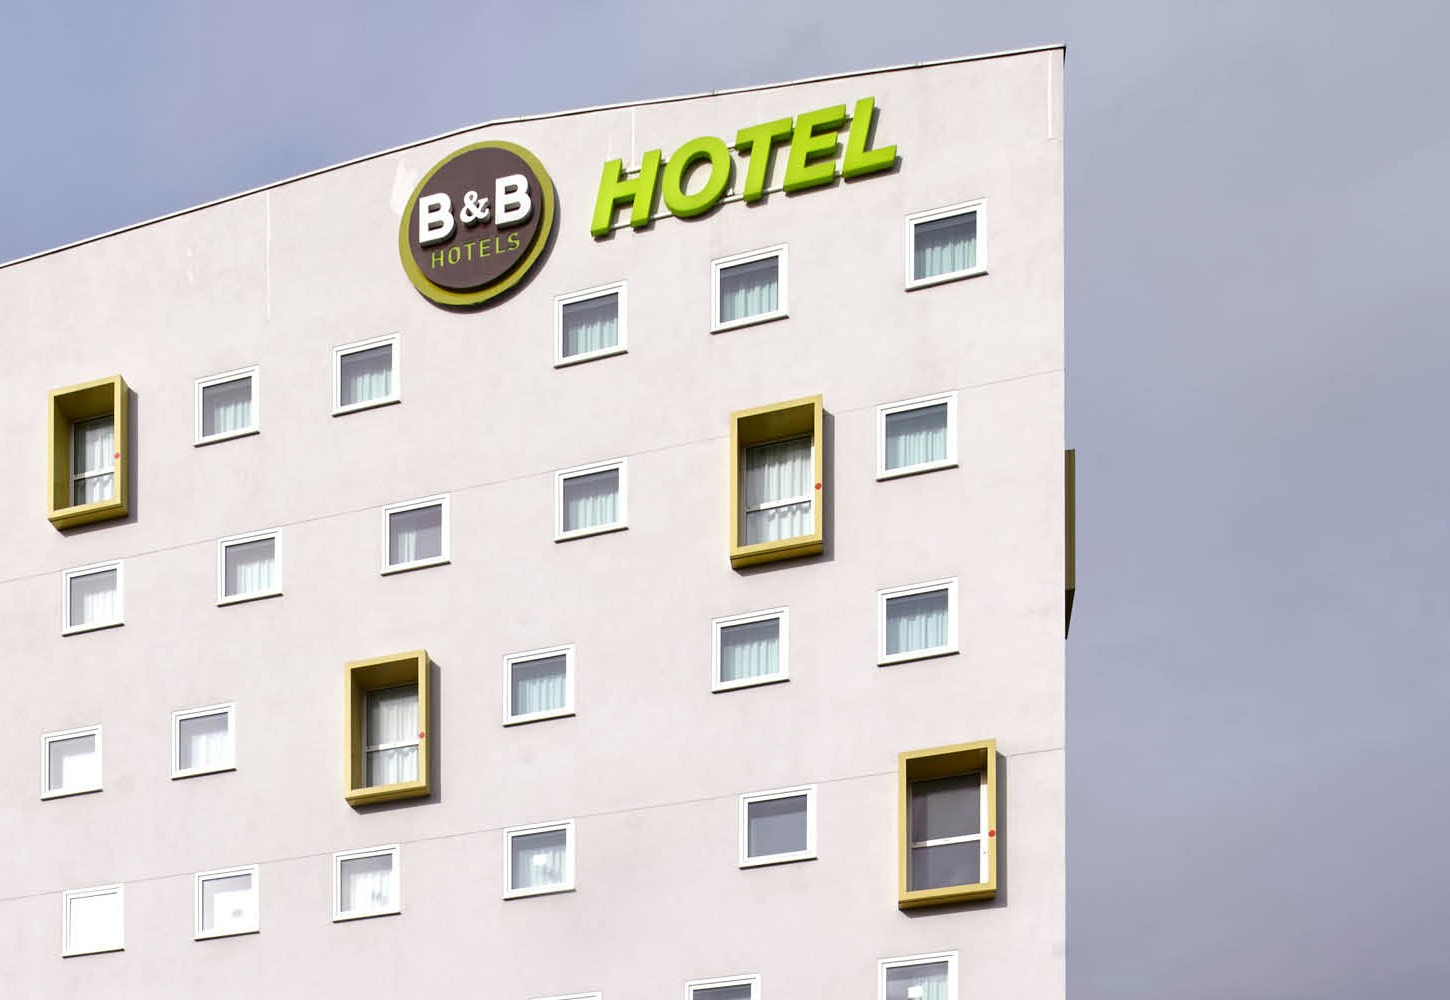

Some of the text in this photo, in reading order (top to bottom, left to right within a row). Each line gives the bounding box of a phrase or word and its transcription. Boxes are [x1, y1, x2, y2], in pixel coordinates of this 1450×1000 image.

[591, 96, 898, 238] HOTEL
[418, 173, 533, 247] B&B
[431, 232, 521, 269] HOTELS
